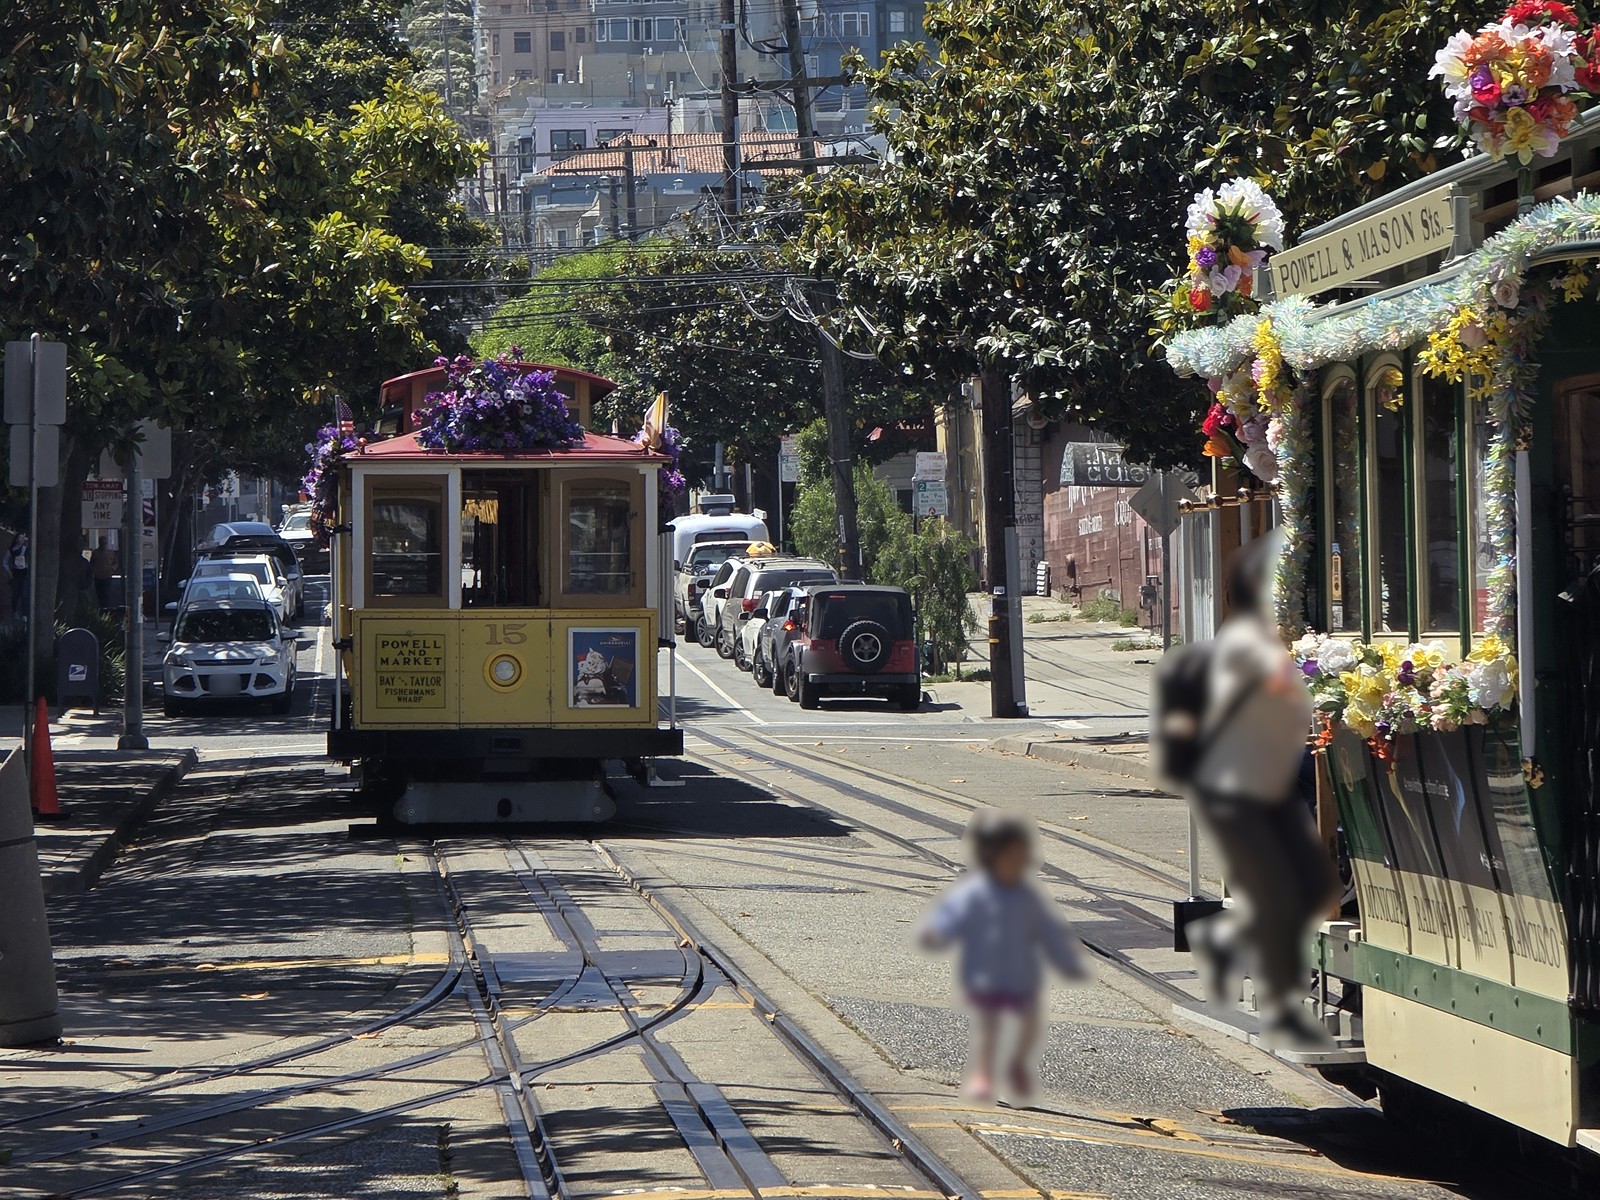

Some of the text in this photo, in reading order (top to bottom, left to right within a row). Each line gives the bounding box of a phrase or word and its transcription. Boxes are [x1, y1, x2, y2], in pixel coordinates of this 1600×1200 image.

[1279, 207, 1445, 293] POWELL & MASON Sts.
[919, 483, 925, 491] 2
[82, 490, 122, 500] NO STOPPING
[94, 502, 110, 510] ANY
[92, 511, 112, 520] TIME
[485, 623, 528, 645] 15
[381, 639, 442, 649] POWELL
[397, 649, 427, 657] AND
[380, 657, 443, 666] MARKET
[379, 675, 395, 686] BAY
[410, 676, 442, 687] TAYLOR
[384, 688, 436, 696] FISHERMANS
[1458, 905, 1471, 942] OF
